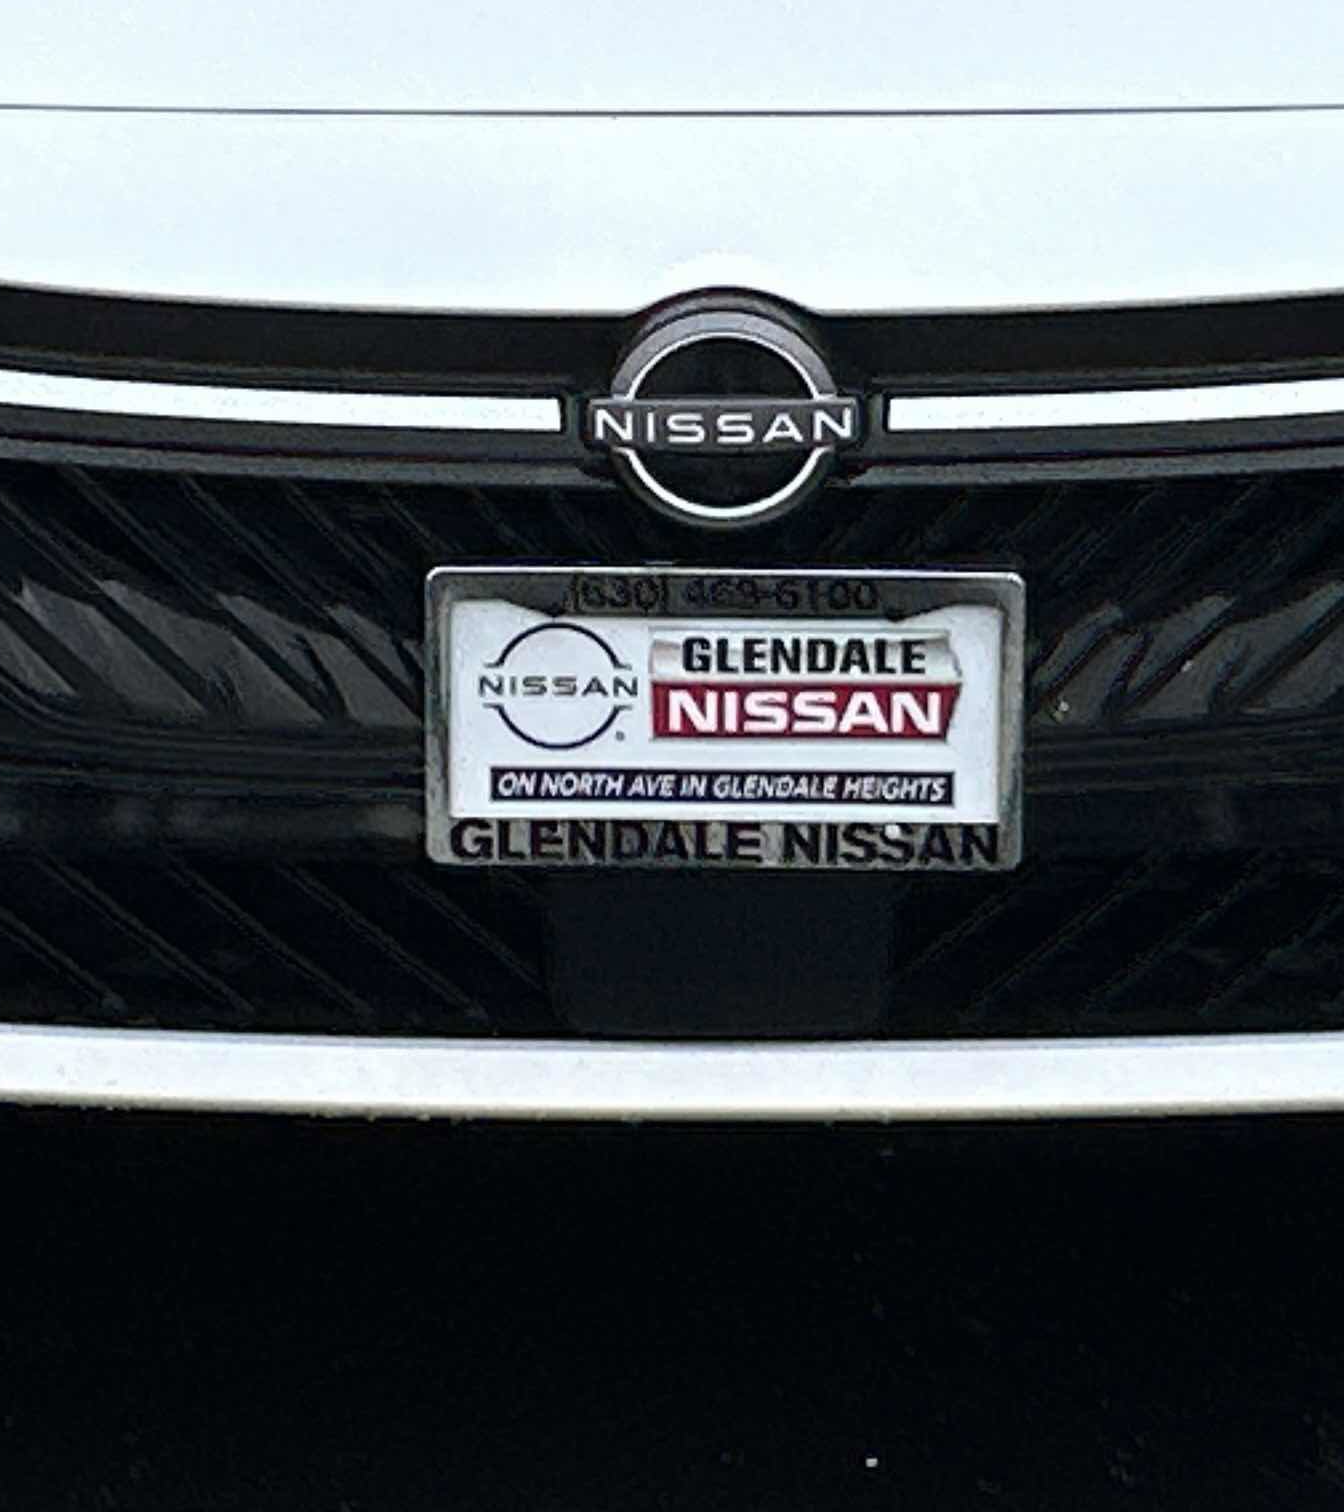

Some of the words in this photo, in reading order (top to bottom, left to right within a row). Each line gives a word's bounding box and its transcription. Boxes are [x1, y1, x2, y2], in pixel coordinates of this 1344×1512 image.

[594, 408, 853, 443] NISSAN
[682, 637, 927, 675] GLENDALE
[478, 675, 639, 697] NISSAN
[669, 688, 941, 733] NISSAN
[499, 772, 537, 796] ON
[540, 772, 625, 797] NORTH
[628, 774, 676, 797] AVE
[679, 775, 707, 797] IN
[713, 775, 838, 799] GLENDALE
[843, 776, 947, 801] HEIGHTS
[450, 819, 762, 860] GLENDALE
[783, 822, 998, 864] NISSAN
